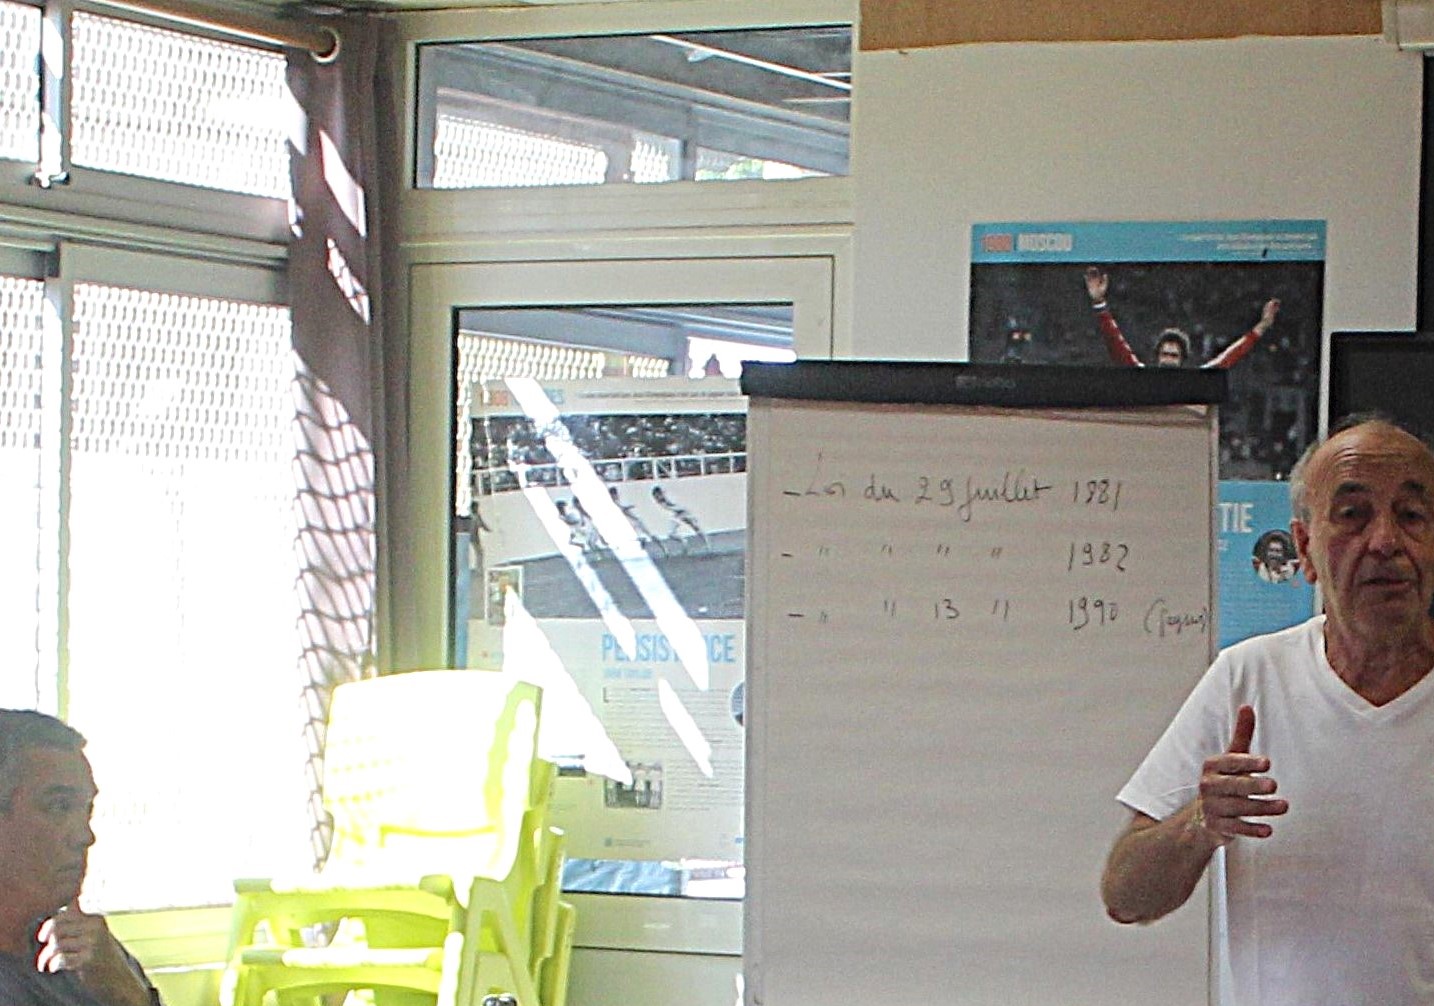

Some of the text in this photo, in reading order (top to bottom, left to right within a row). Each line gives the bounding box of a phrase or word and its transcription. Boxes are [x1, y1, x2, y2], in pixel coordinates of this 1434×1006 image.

[863, 473, 900, 502] du
[914, 476, 955, 506] 29
[1067, 542, 1129, 573] 1982
